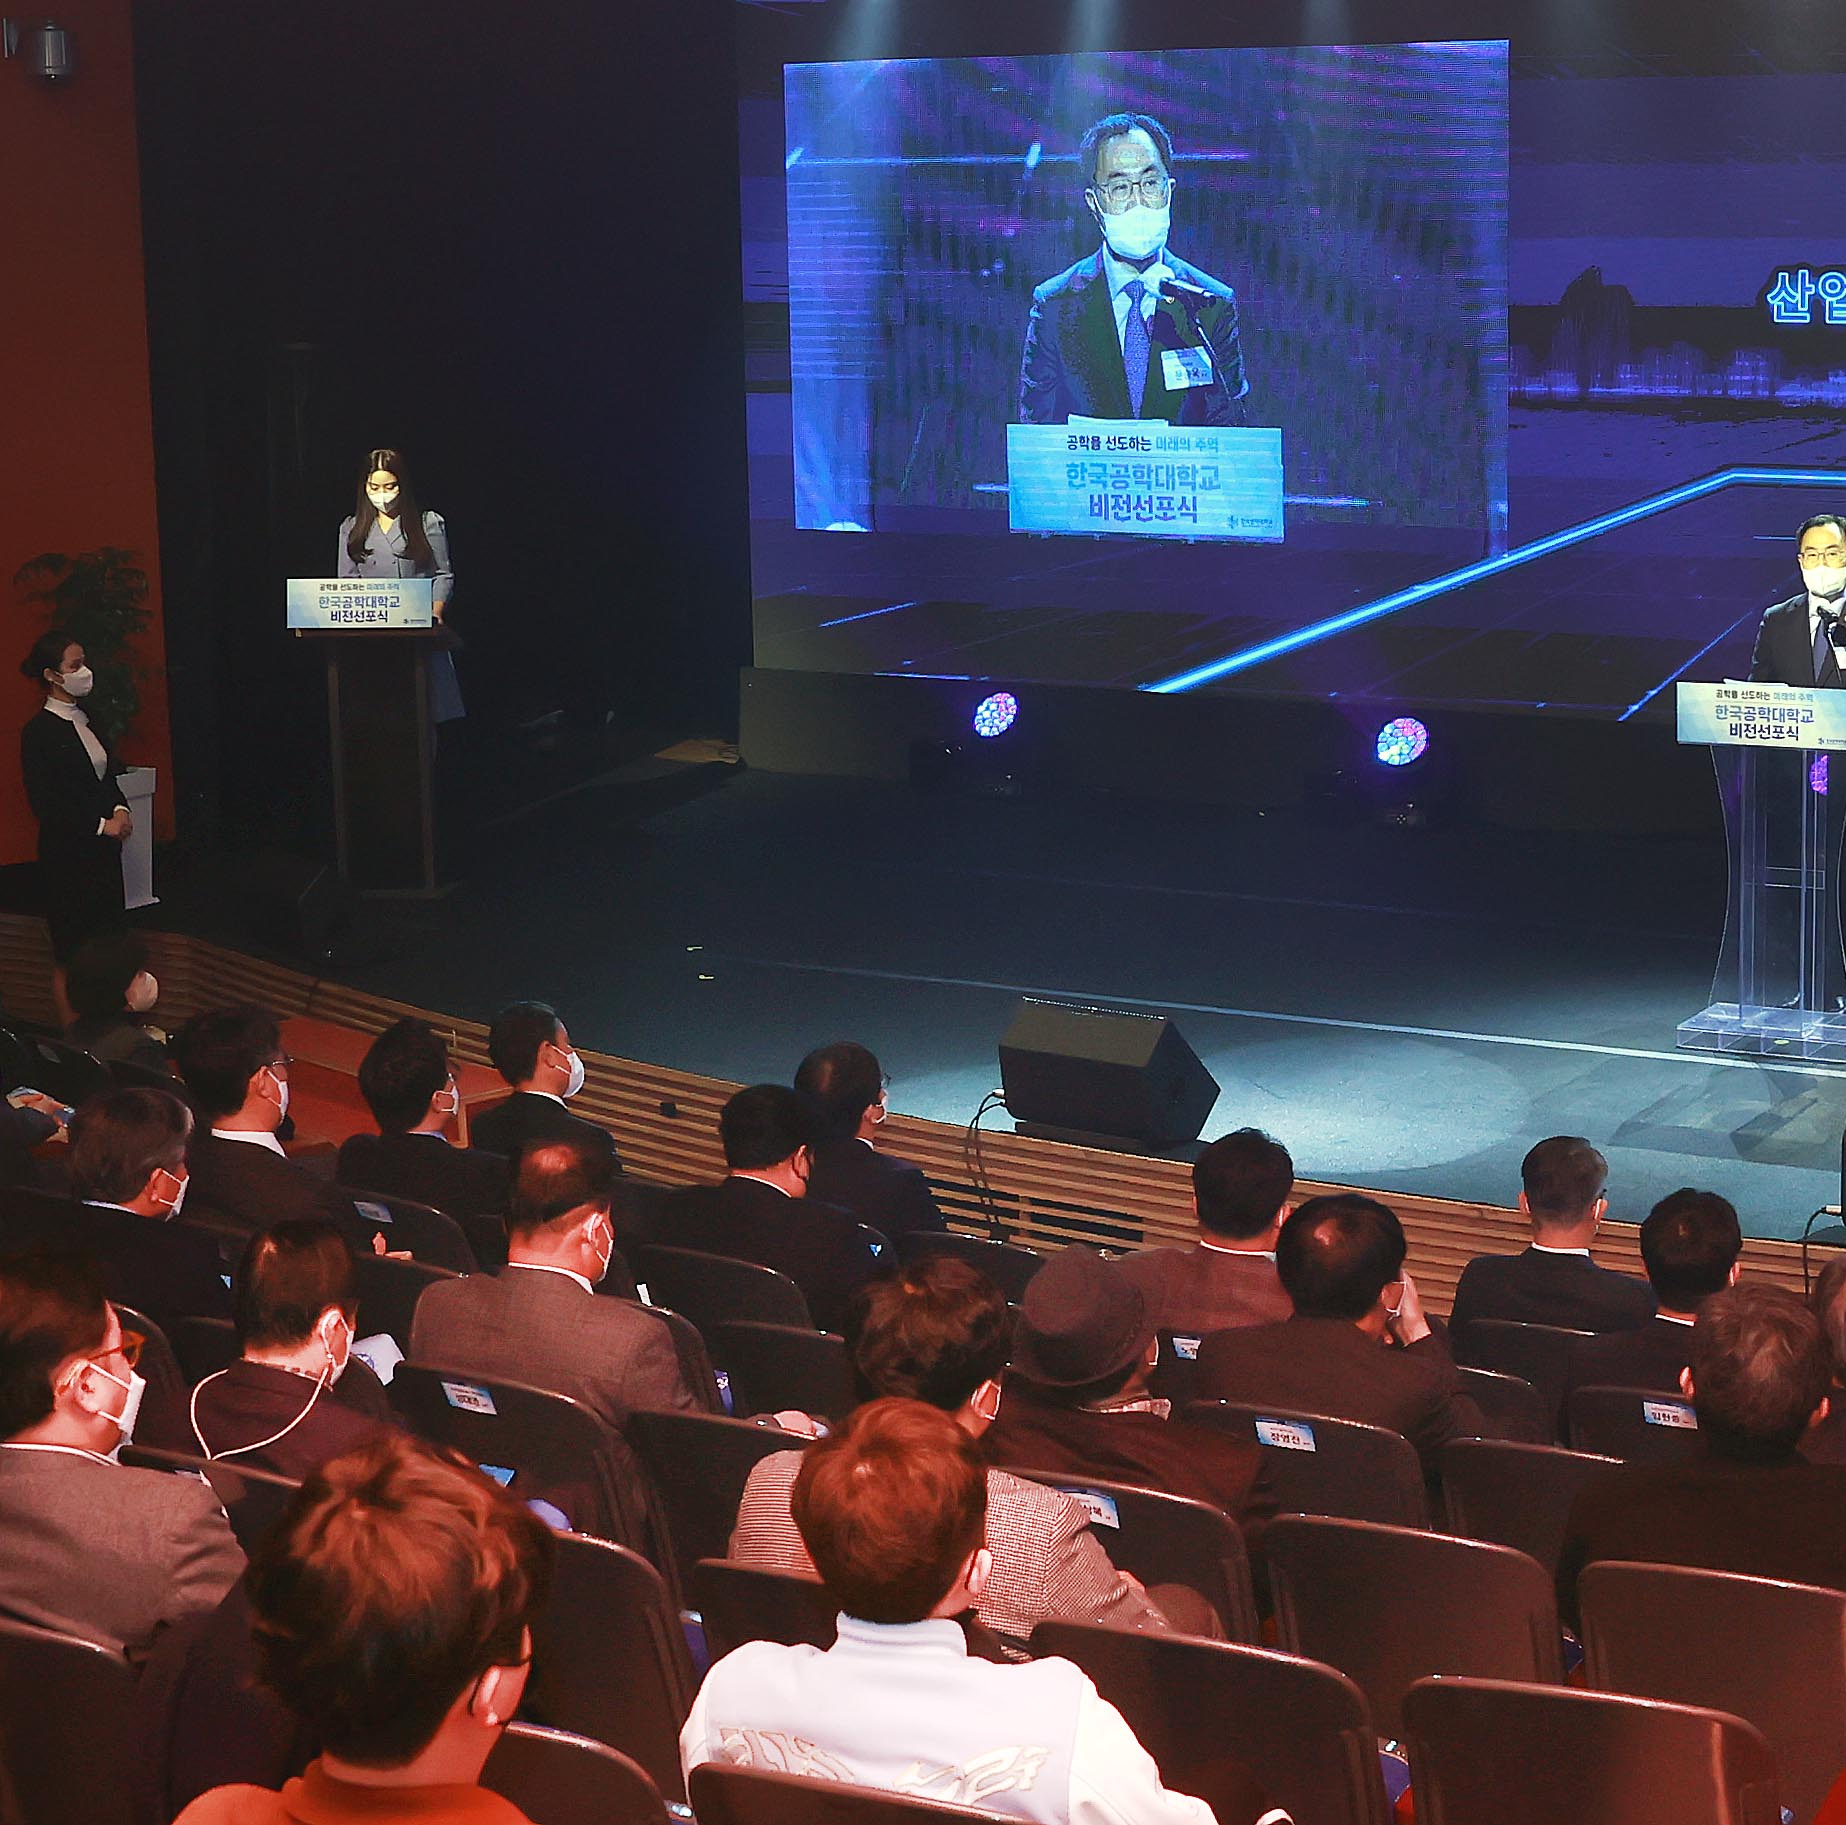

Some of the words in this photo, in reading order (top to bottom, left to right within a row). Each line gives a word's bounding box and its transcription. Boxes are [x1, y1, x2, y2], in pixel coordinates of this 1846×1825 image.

[1066, 435, 1101, 451] 공학을
[1105, 436, 1152, 452] 선도하는
[1155, 436, 1191, 452] 미래의
[1066, 462, 1222, 491] 한국공학대학교
[1089, 494, 1198, 524] 비전선포식
[318, 595, 401, 609] 한국공학대학교
[330, 609, 389, 623] 비전선포식
[1715, 705, 1815, 724] 한국공학대학교
[1729, 723, 1800, 741] 비전선포식
